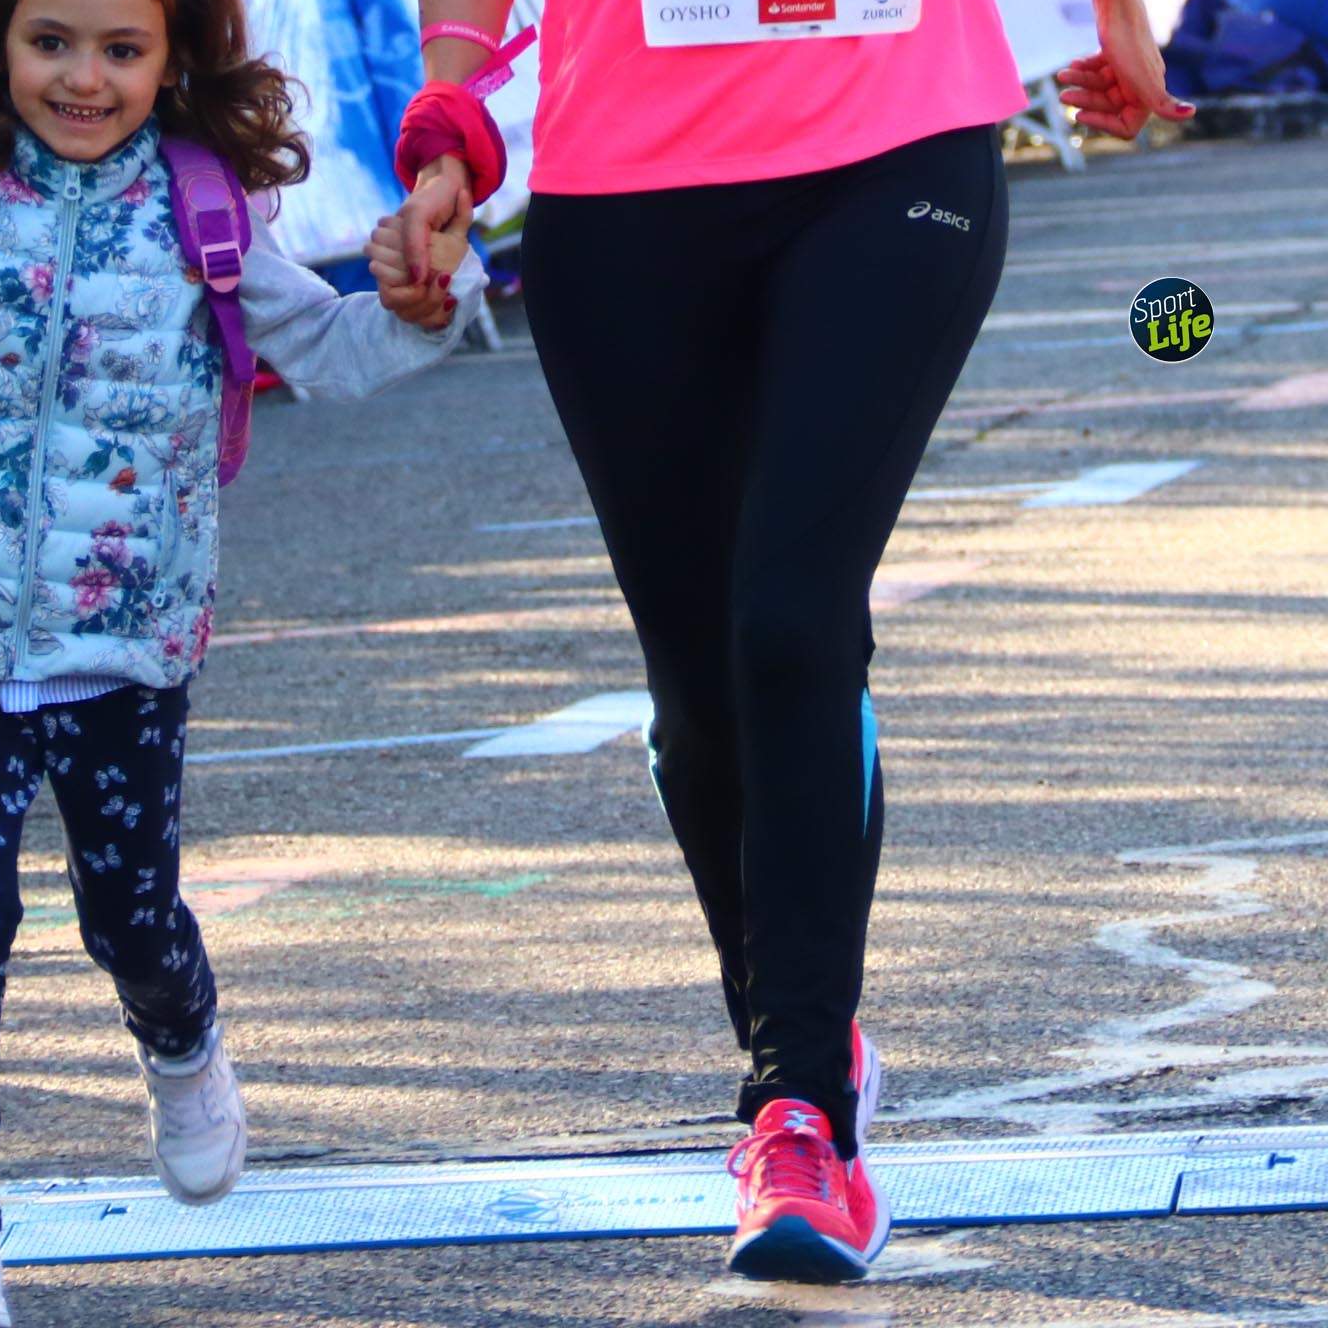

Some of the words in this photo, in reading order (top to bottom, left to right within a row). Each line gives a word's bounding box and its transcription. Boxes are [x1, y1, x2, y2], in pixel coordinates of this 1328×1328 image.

[659, 3, 730, 23] OYSHO
[781, 1, 826, 14] Santander
[862, 8, 903, 20] ZURICH
[931, 208, 971, 232] asics
